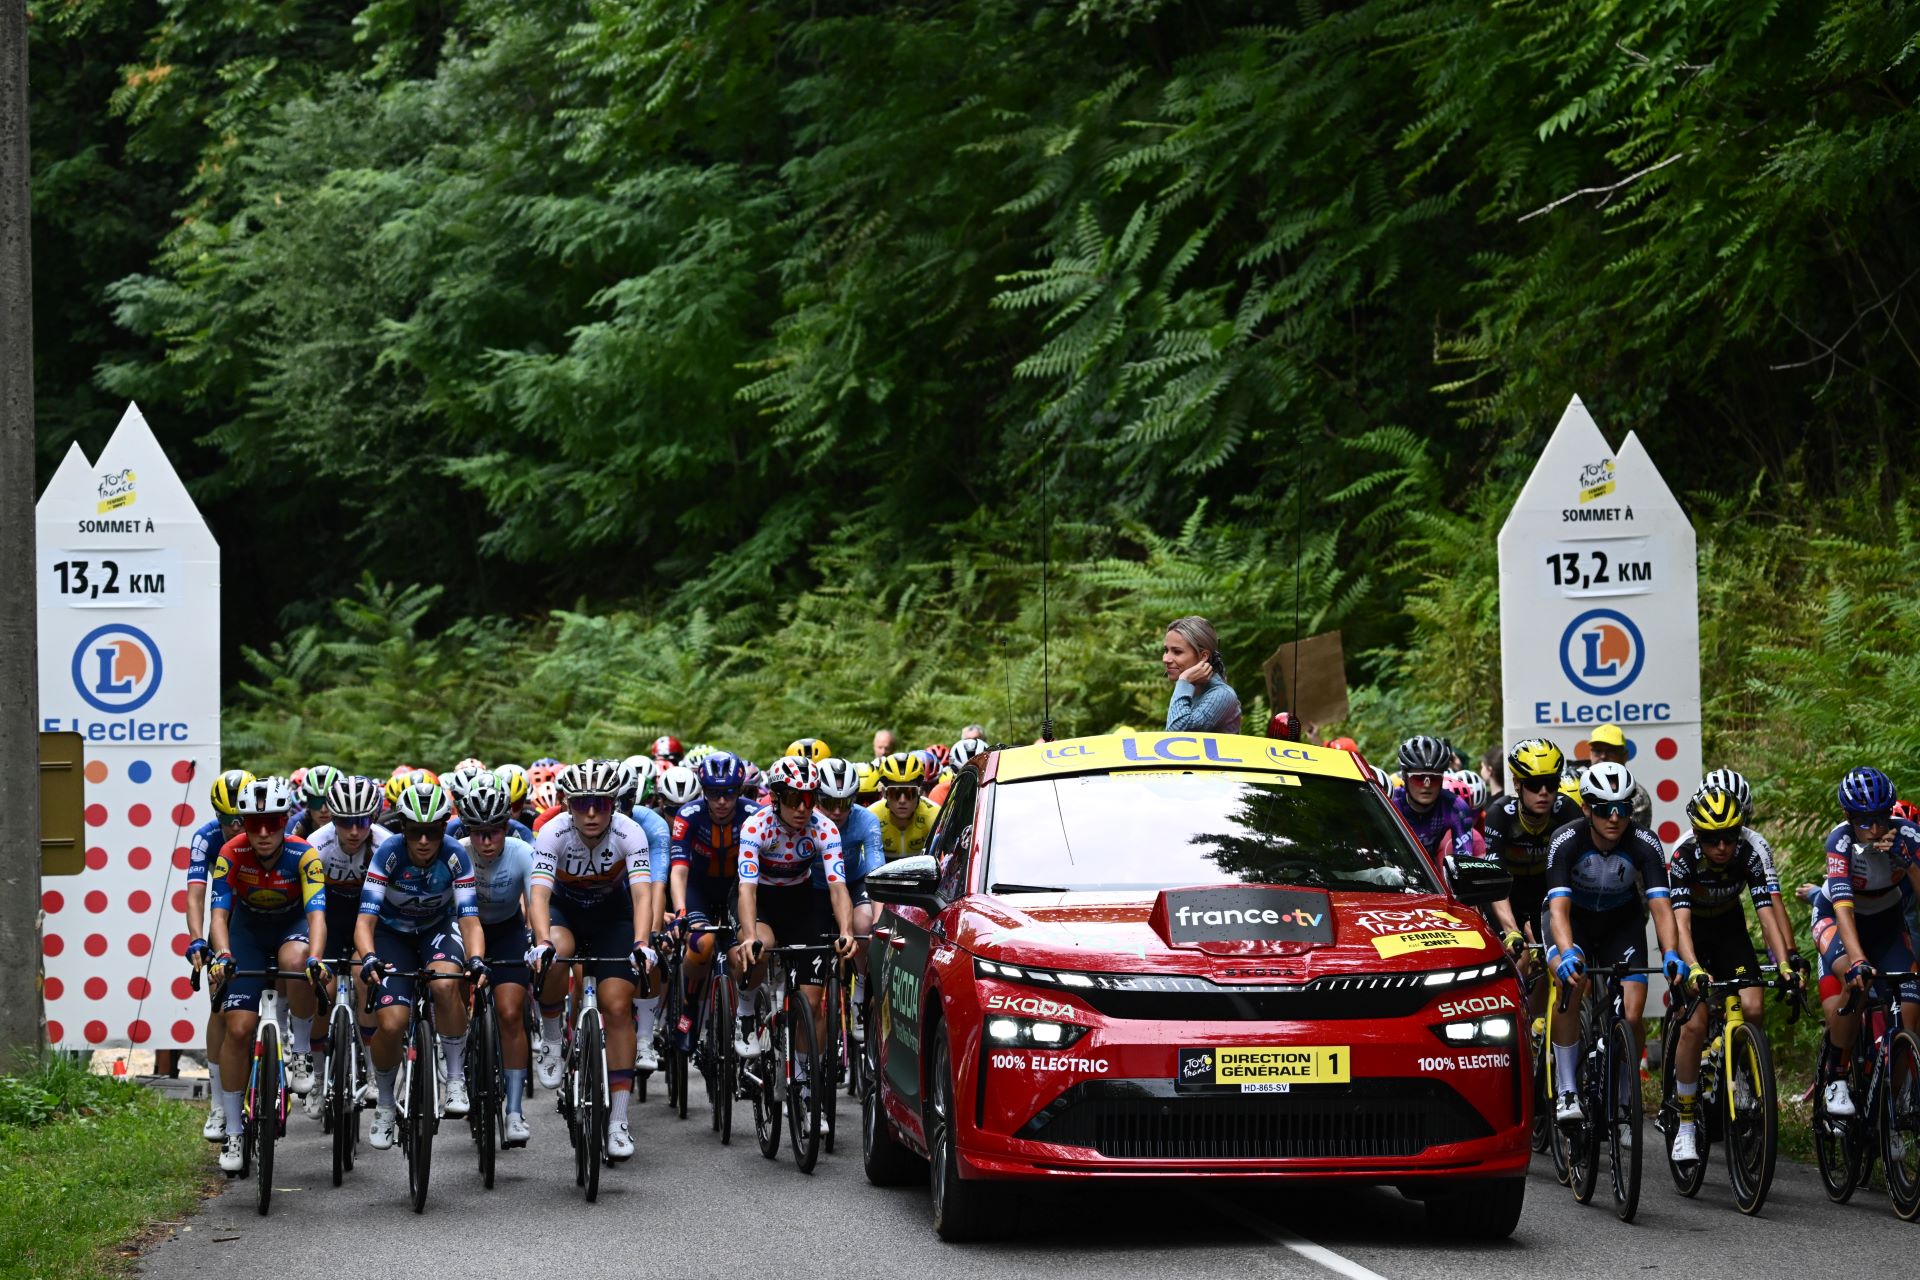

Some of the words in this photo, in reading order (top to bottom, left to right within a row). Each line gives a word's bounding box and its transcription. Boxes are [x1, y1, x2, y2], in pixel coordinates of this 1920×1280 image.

[1562, 508, 1621, 522] SOMMET
[1624, 504, 1634, 521] À
[78, 519, 141, 533] SOMMET
[145, 517, 155, 533] À
[1545, 551, 1610, 590] 13,2
[1618, 561, 1651, 582] KM
[54, 561, 119, 599] 13,2
[130, 574, 165, 593] KM
[1535, 700, 1671, 724] E.Leclerc
[44, 718, 188, 741] ELeclerc
[1046, 745, 1095, 759] LCL
[1122, 736, 1243, 763] LCL
[1270, 746, 1318, 761] LCL
[1400, 931, 1456, 942] FEMMES
[991, 1055, 1026, 1070] 100%
[1031, 1056, 1109, 1073] ELECTRIC
[1221, 1053, 1311, 1064] DIRECTION
[1328, 1053, 1338, 1075] 1
[1221, 1064, 1311, 1077] GÉNÉRALE
[1417, 1057, 1455, 1071] 100%
[1458, 1054, 1510, 1070] ELECTRIC
[1244, 1084, 1288, 1092] HD-865-SV
